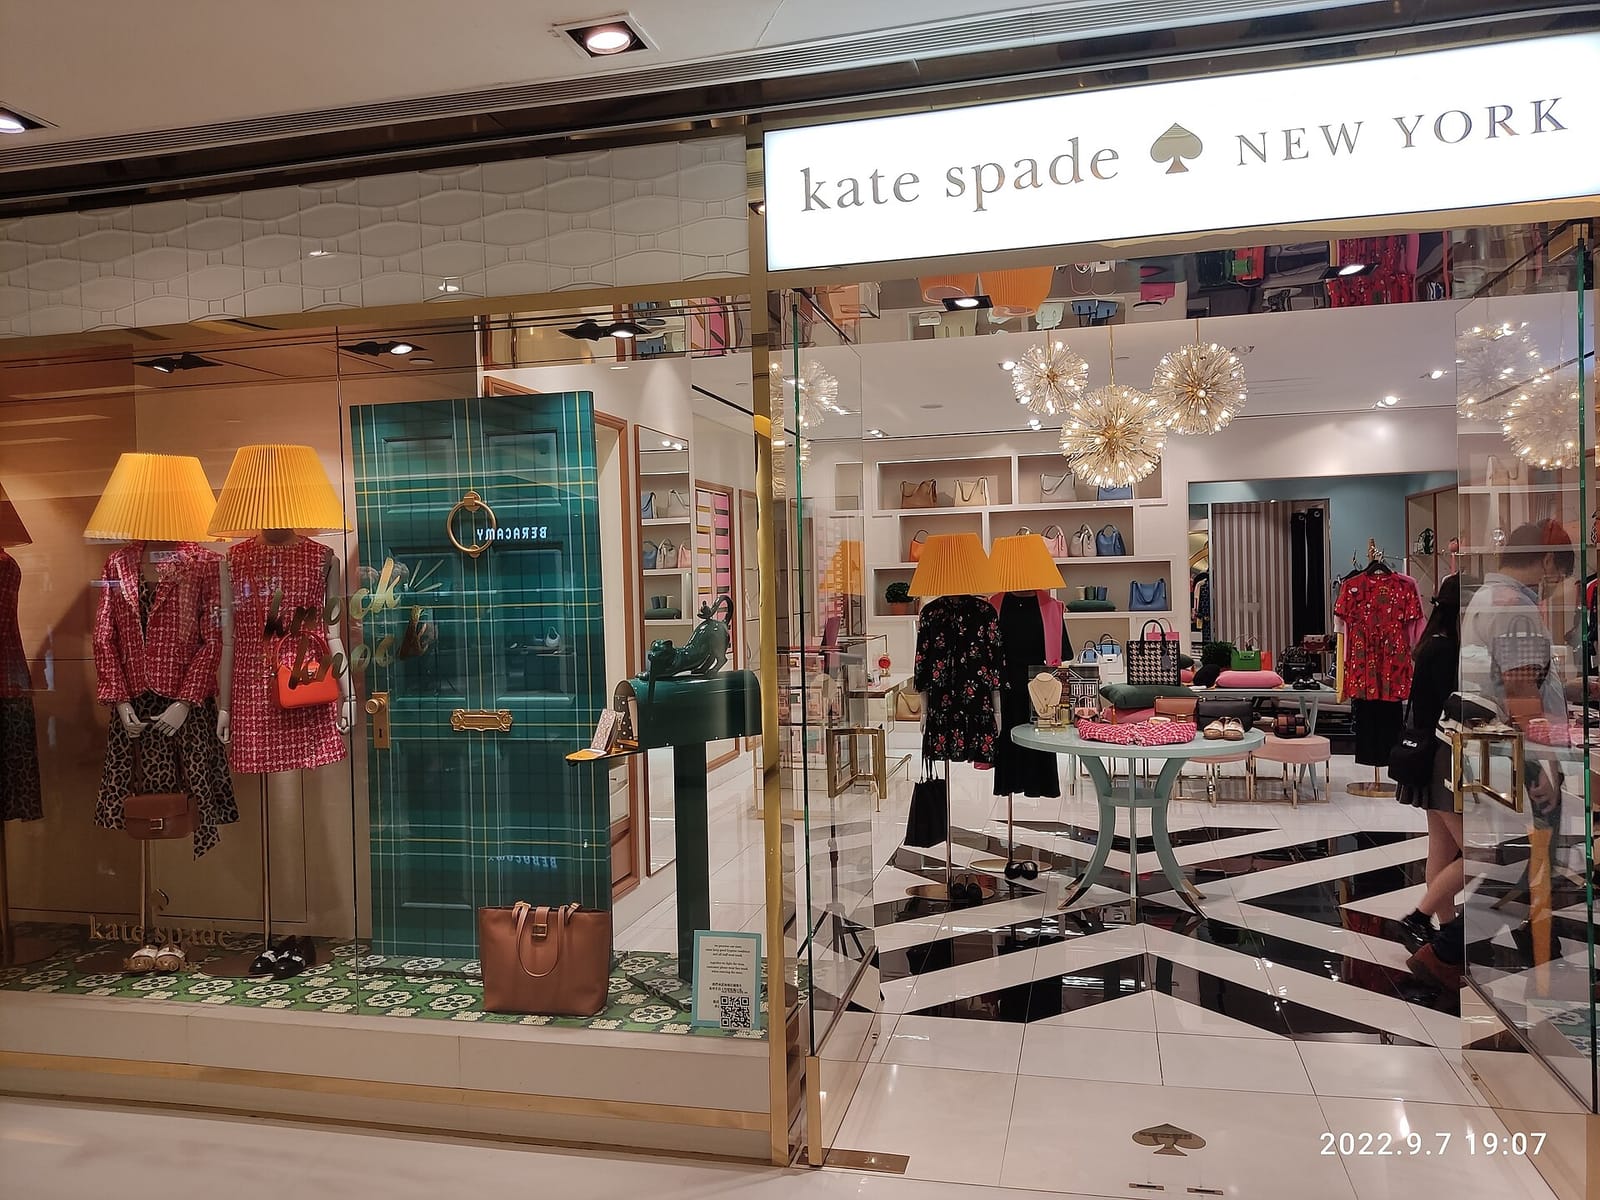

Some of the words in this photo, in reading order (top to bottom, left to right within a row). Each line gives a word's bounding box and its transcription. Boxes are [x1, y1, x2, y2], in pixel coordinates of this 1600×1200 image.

[800, 166, 920, 212] kate
[946, 136, 1120, 213] spade
[1234, 121, 1364, 167] NEW
[1392, 97, 1568, 149] YORK
[88, 913, 146, 942] kate
[154, 921, 234, 948] spade
